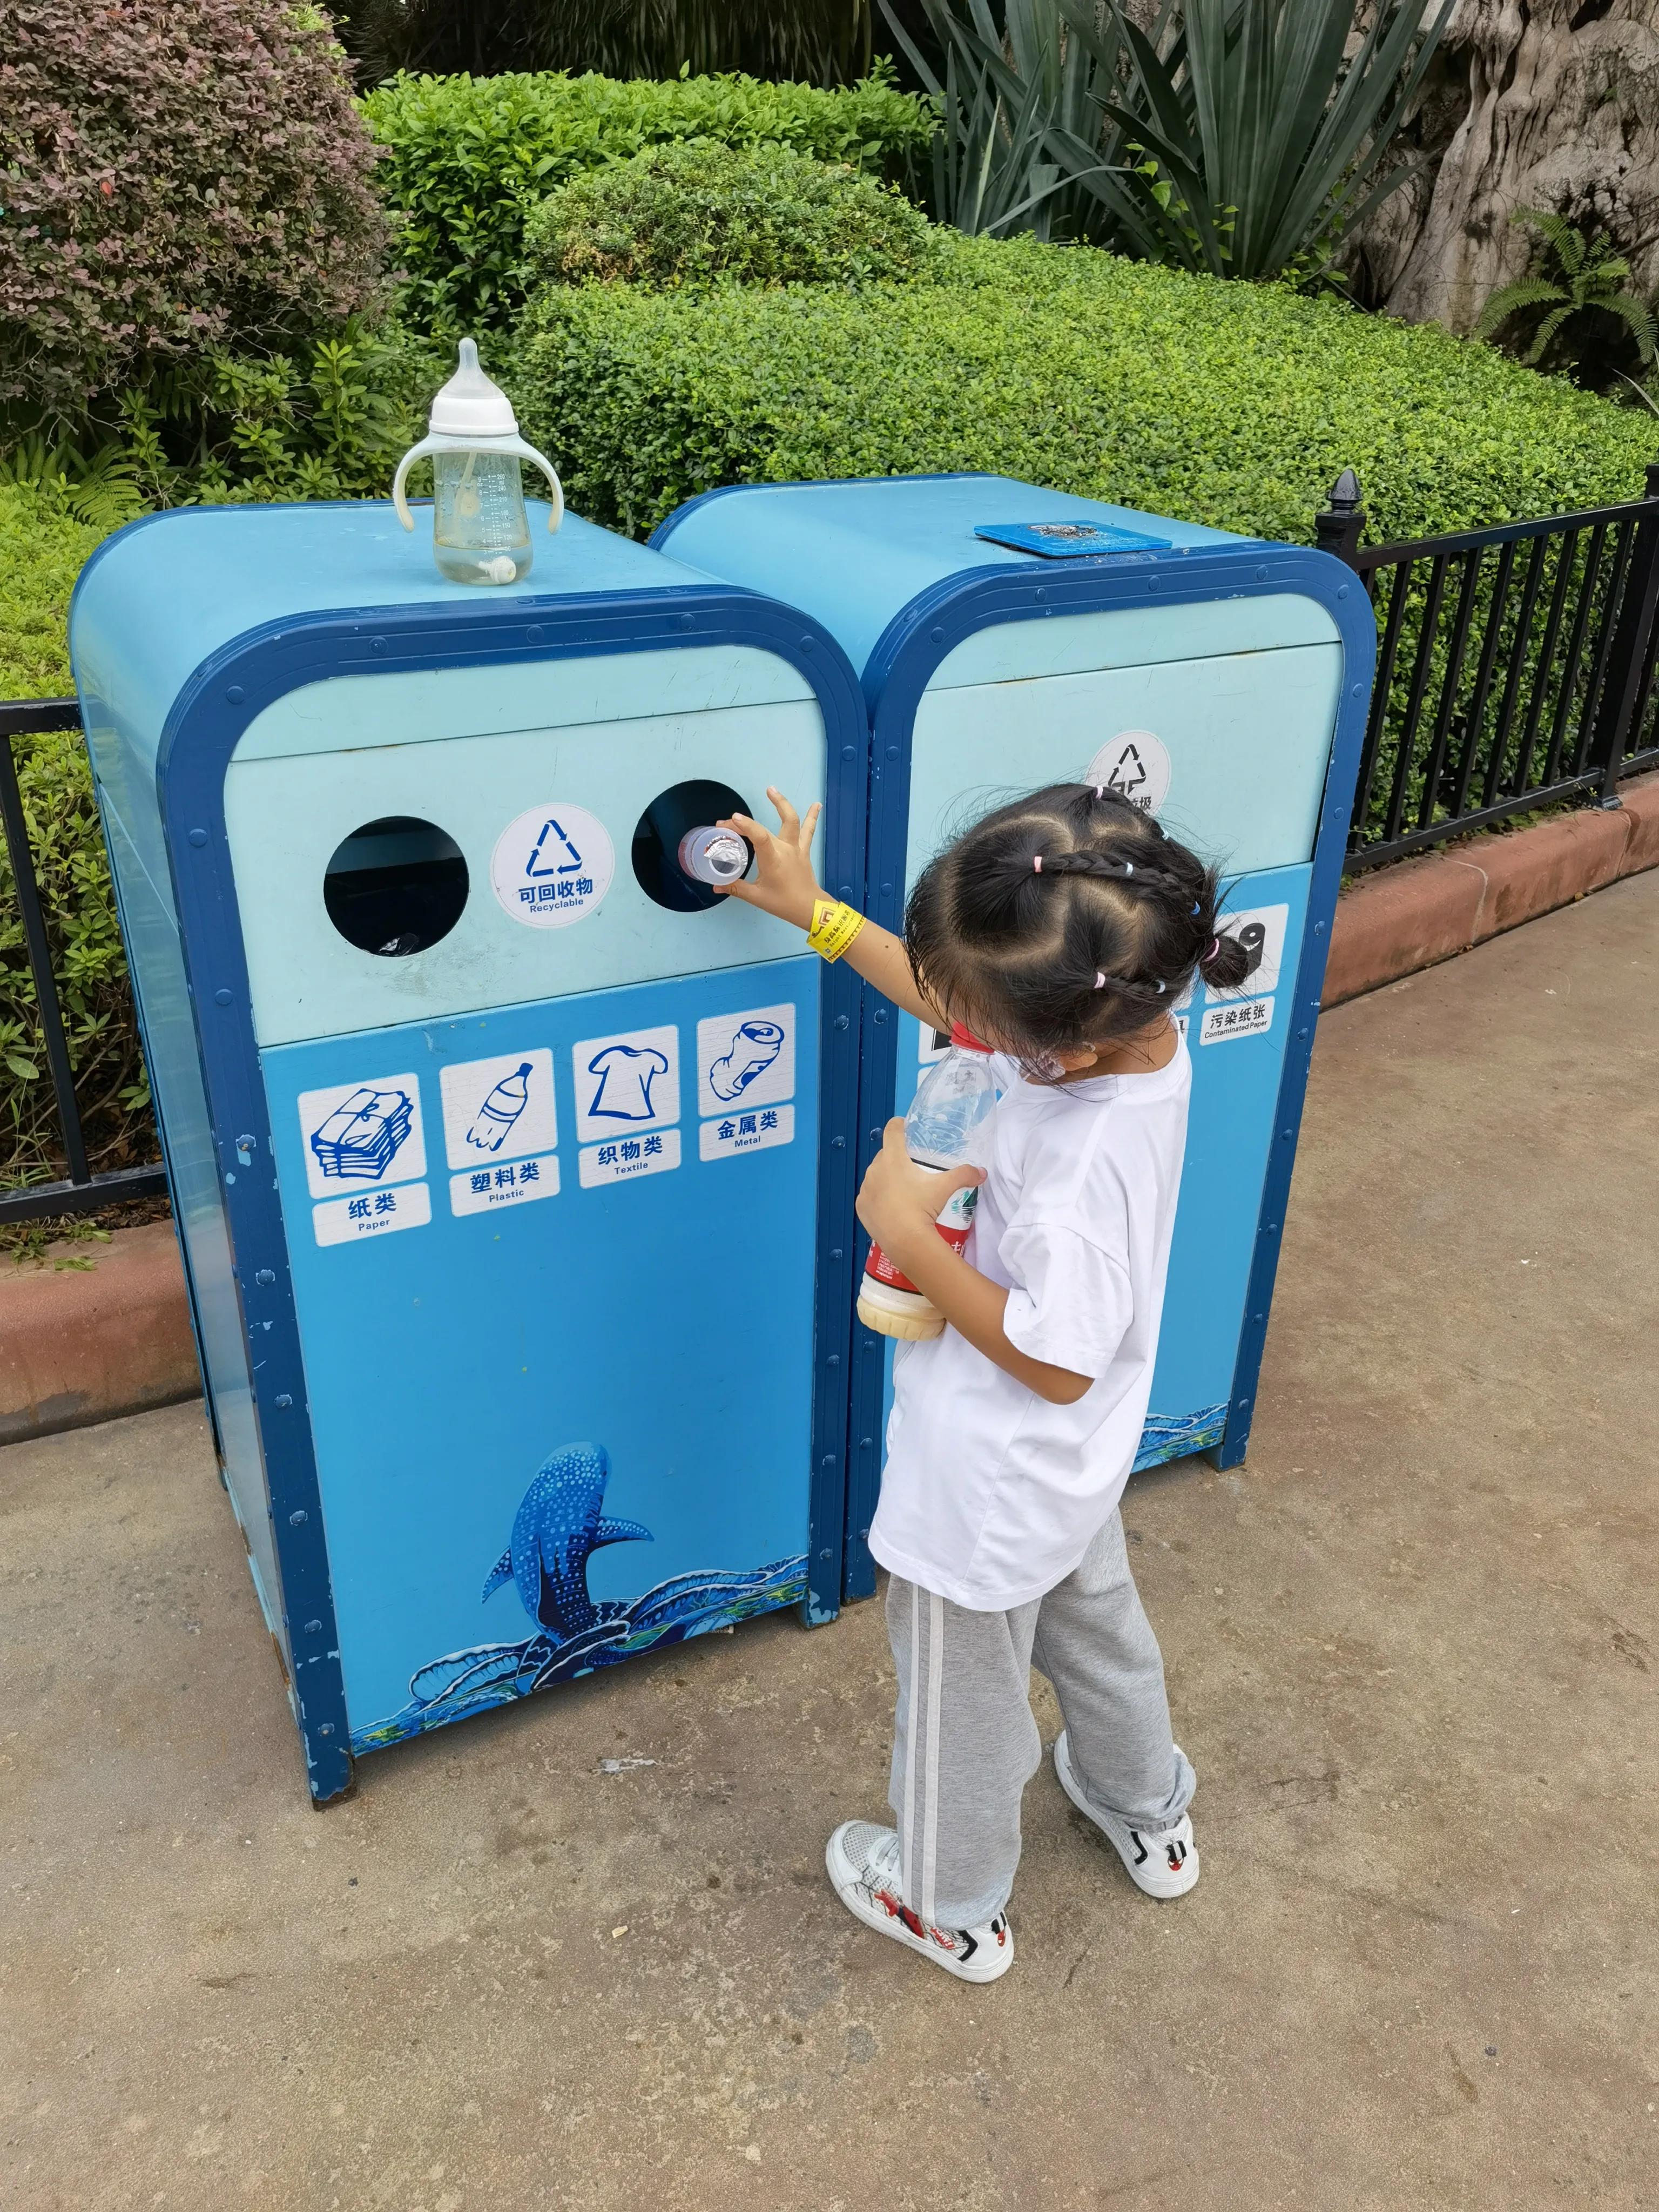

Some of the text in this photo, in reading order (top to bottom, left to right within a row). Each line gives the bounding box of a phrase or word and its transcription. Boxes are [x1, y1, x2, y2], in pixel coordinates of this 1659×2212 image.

[518, 878, 593, 903] 可回收物
[530, 898, 584, 913] Recyclable
[1210, 1004, 1265, 1028] 污染纸张
[1205, 1022, 1249, 1038] Contaminated
[717, 1111, 778, 1140] 金属类
[598, 1136, 663, 1165] 织物类
[734, 1136, 761, 1148] Metal
[470, 1162, 539, 1194] 塑料类
[615, 1162, 649, 1175] Textile
[348, 1192, 397, 1219] 纸类
[489, 1189, 524, 1203] Plastic
[358, 1219, 390, 1231] Paper
